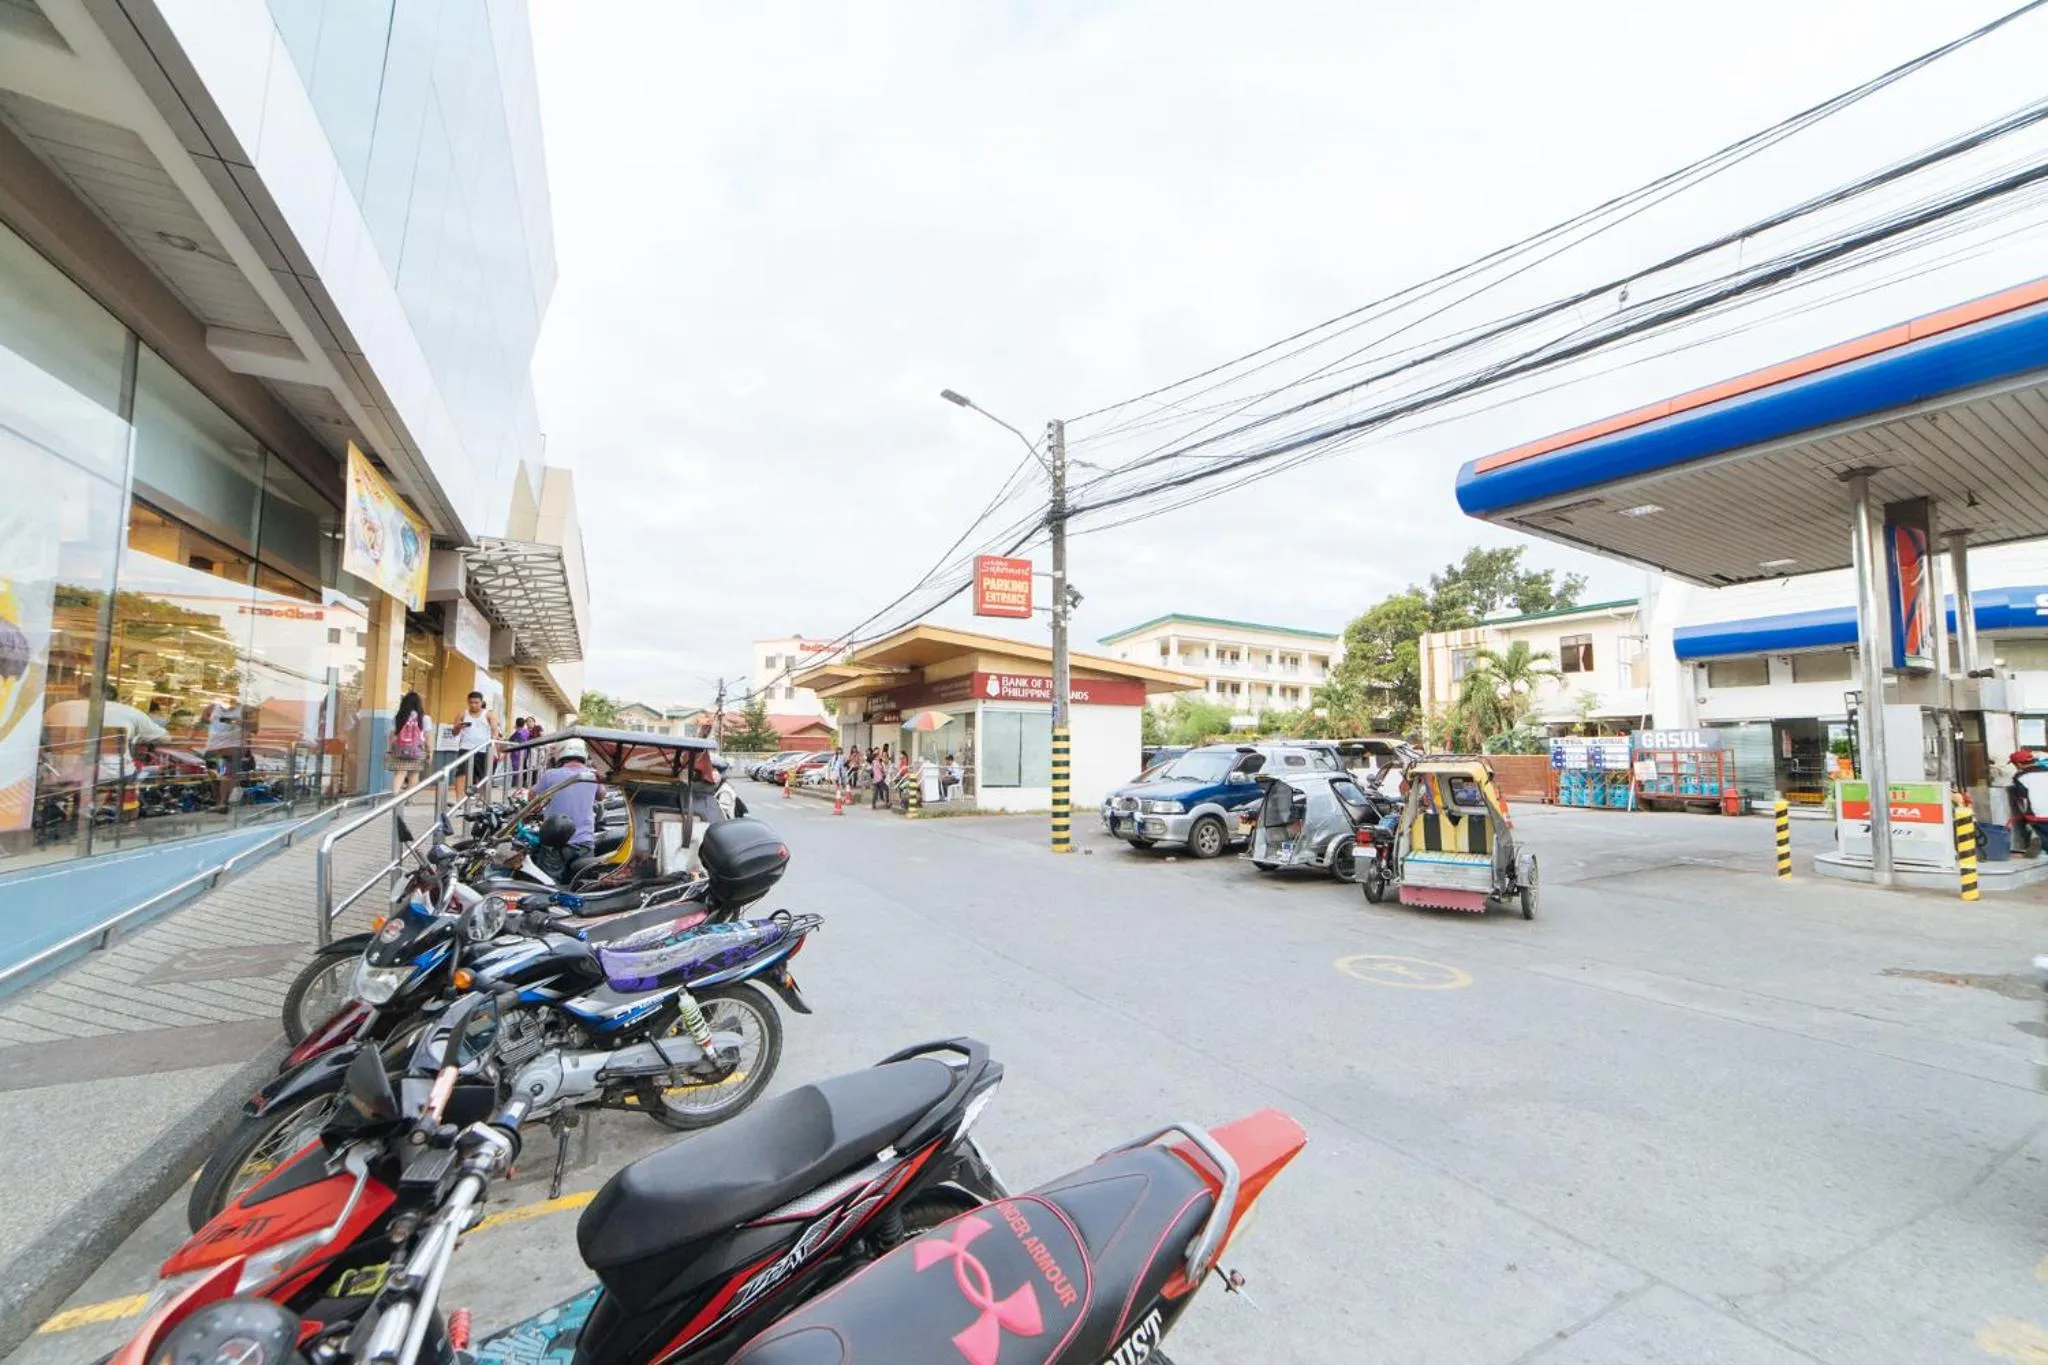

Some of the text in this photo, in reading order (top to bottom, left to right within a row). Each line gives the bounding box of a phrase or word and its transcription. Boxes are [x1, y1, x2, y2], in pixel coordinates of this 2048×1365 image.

[983, 577, 1029, 592] PARKING
[985, 591, 1027, 605] ENTRANCE
[1001, 676, 1028, 687] BANK
[1031, 680, 1043, 689] OF
[1001, 687, 1051, 699] PHILIPPINE
[1642, 731, 1708, 748] GASUL
[1021, 1235, 1079, 1309] ARMOUR
